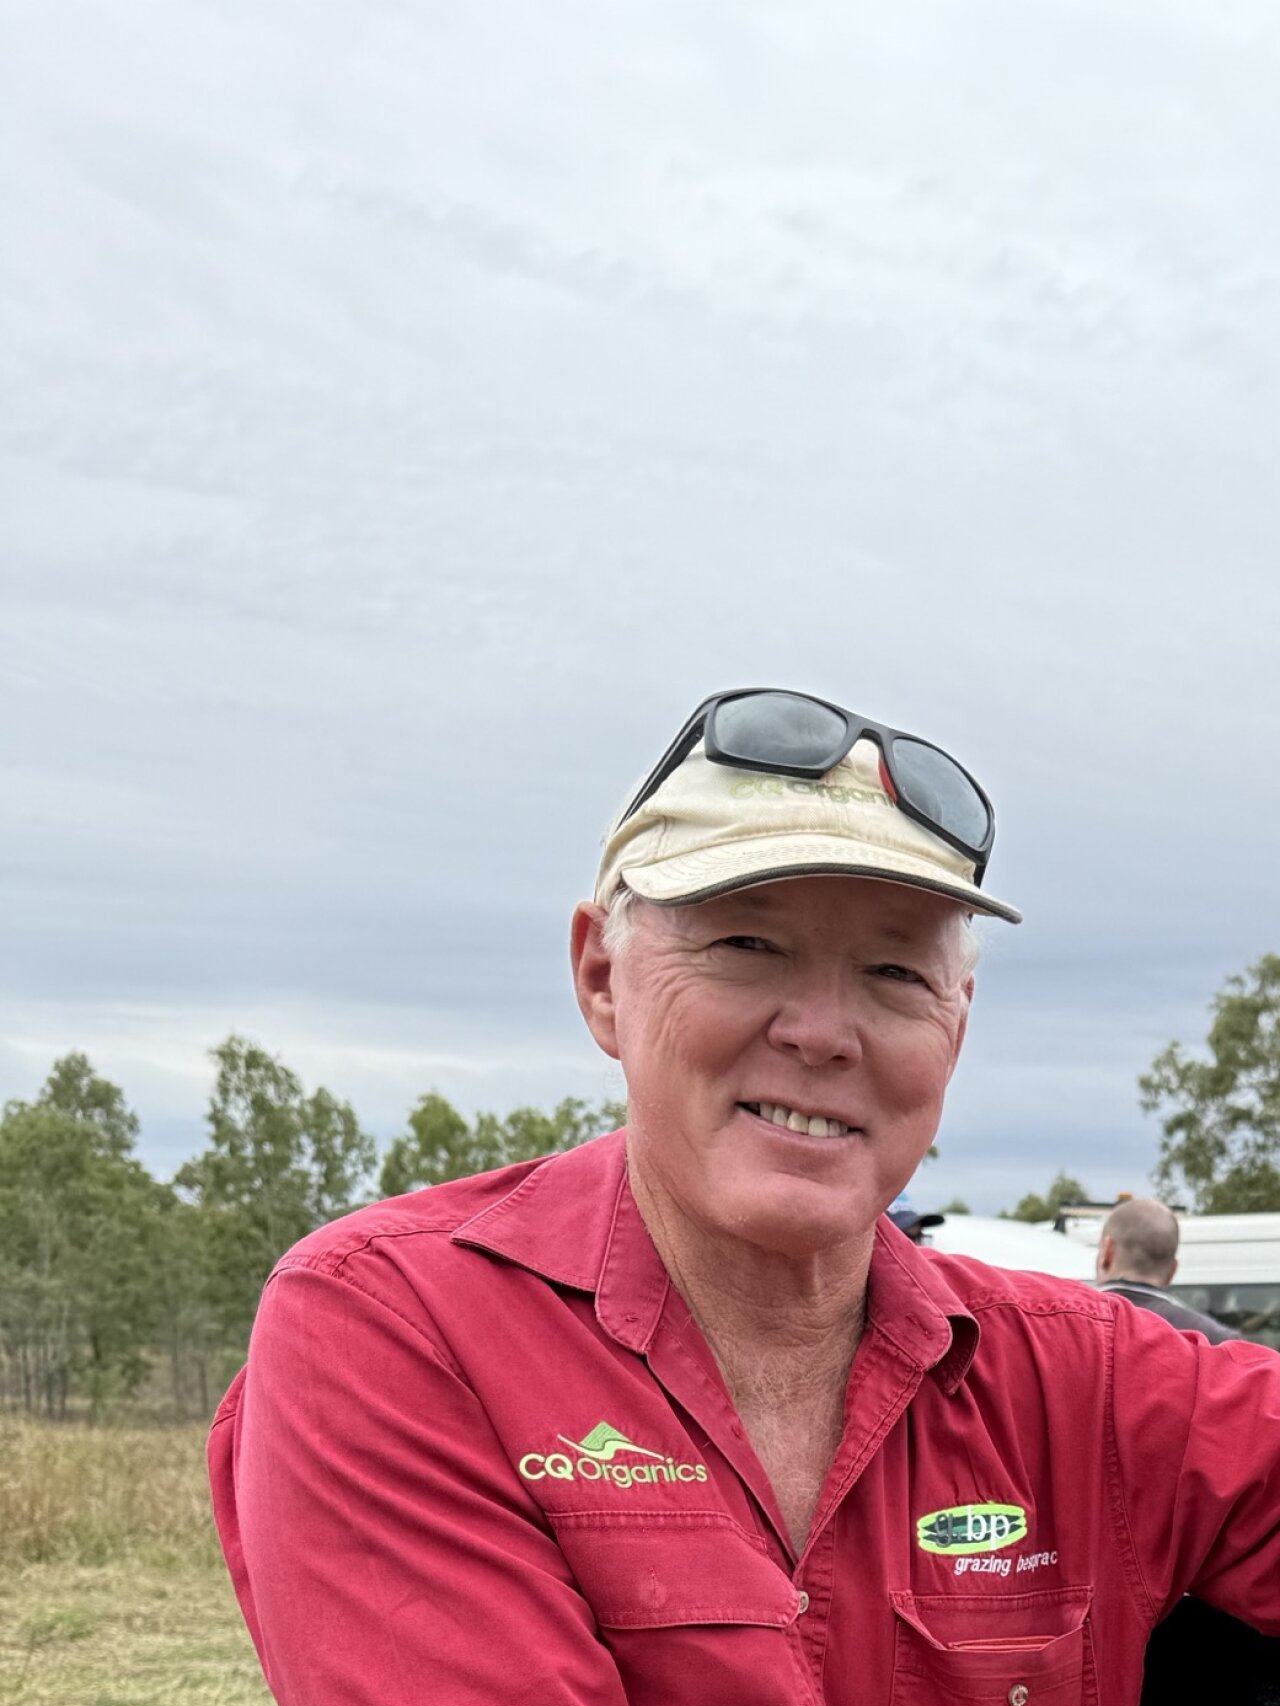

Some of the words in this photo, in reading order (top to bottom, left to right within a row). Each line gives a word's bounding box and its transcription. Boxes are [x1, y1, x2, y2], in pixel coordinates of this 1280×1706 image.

[519, 1453, 574, 1480] CQ
[577, 1457, 708, 1488] Organics
[954, 1555, 1011, 1576] grazing
